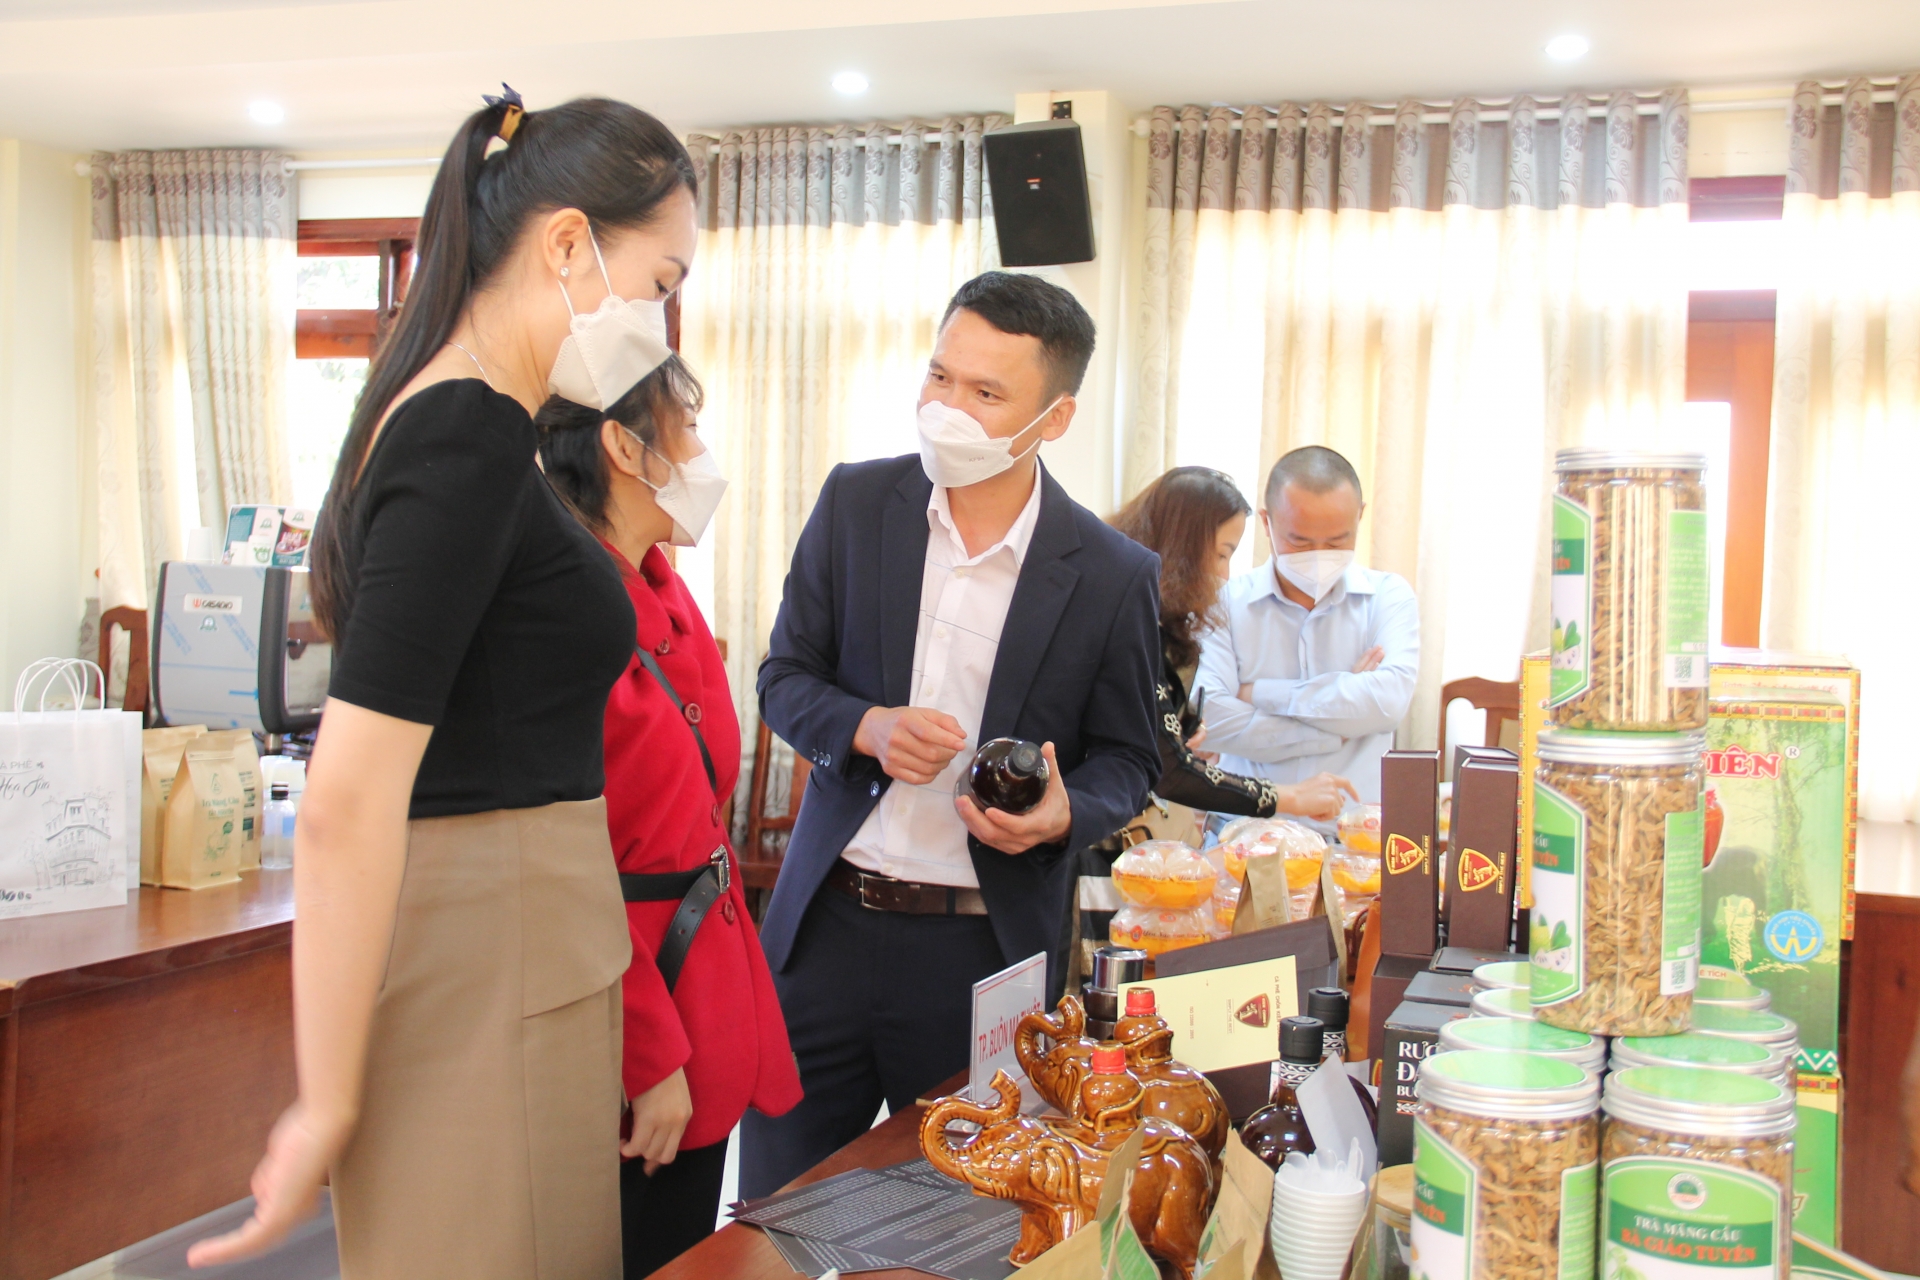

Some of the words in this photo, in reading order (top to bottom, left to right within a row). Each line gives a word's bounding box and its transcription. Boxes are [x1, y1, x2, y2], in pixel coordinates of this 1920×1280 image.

[1701, 744, 1782, 780] IÊN
[989, 1015, 1009, 1058] BUÔN
[1634, 1214, 1661, 1233] TRÀ
[1620, 1228, 1642, 1247] BÀ
[1643, 1235, 1692, 1259] GIÁO
